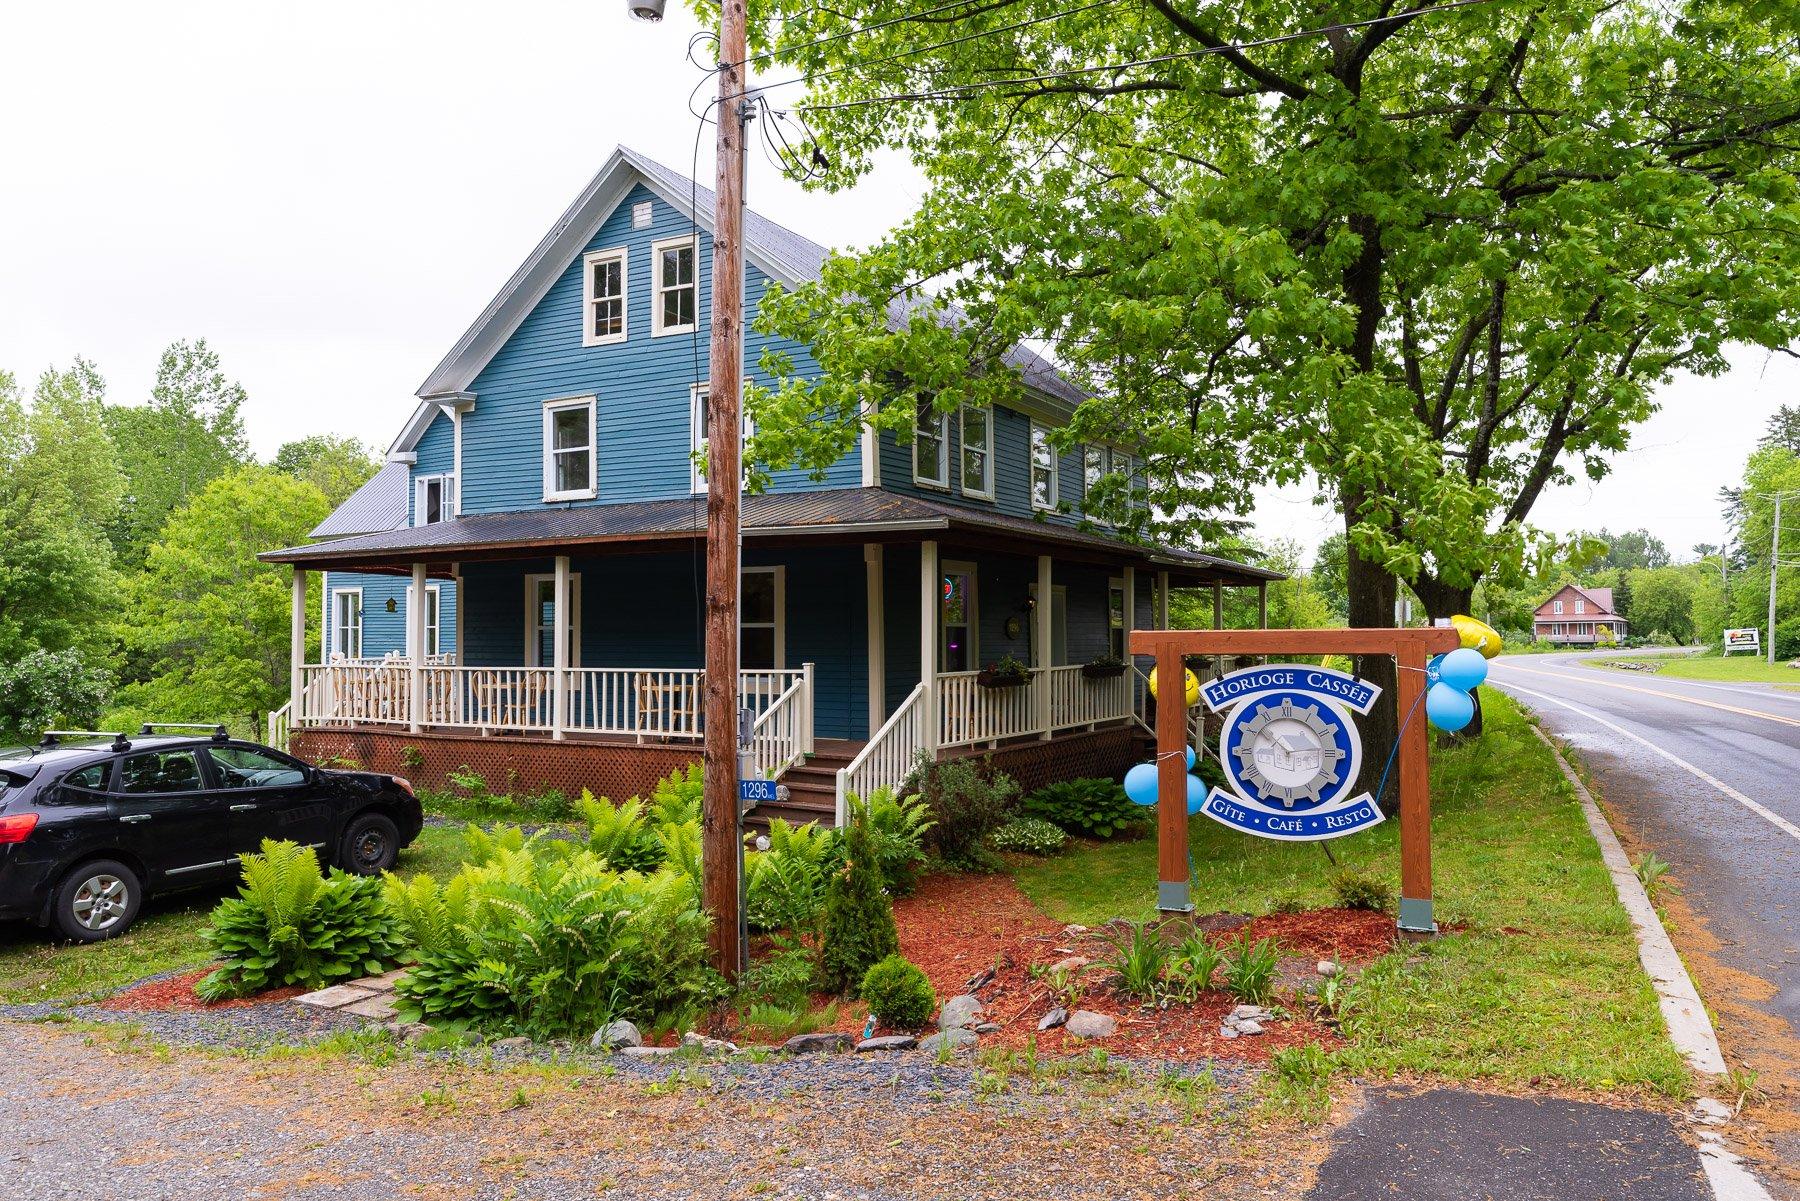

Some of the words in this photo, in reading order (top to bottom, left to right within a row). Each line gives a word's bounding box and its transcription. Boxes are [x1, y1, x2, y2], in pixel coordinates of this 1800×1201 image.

[1210, 673, 1294, 702] HORLOGE
[1307, 673, 1369, 704] CASSÉE
[1260, 711, 1272, 722] XI
[1281, 706, 1292, 717] XII
[1318, 728, 1330, 738] II
[1324, 749, 1336, 758] III
[1246, 763, 1260, 779] VIII
[742, 782, 768, 798] 1296
[1261, 779, 1274, 794] VII
[1284, 788, 1292, 798] VI
[1212, 799, 1246, 822] GÎTE
[1267, 817, 1303, 832] CAFÉ
[1324, 806, 1372, 829] RESTO
